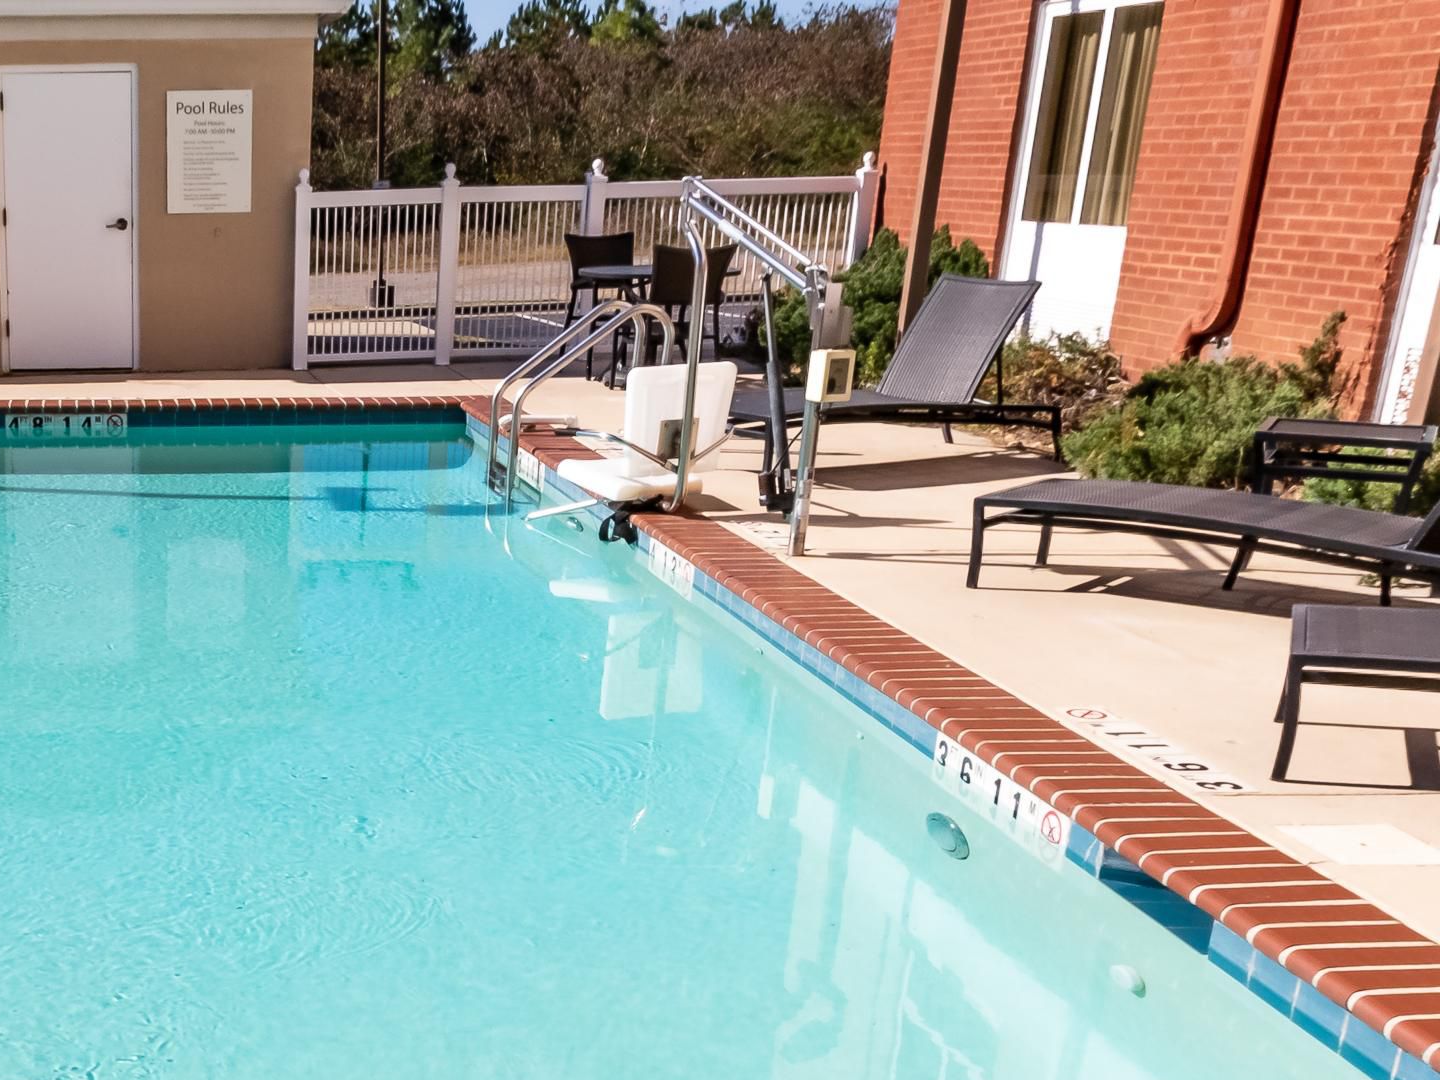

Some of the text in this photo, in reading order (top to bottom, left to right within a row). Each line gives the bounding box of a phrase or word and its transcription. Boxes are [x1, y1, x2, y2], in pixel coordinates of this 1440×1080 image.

[176, 101, 244, 115] Pool Rules
[936, 740, 949, 767] 3
[960, 756, 973, 785] 6
